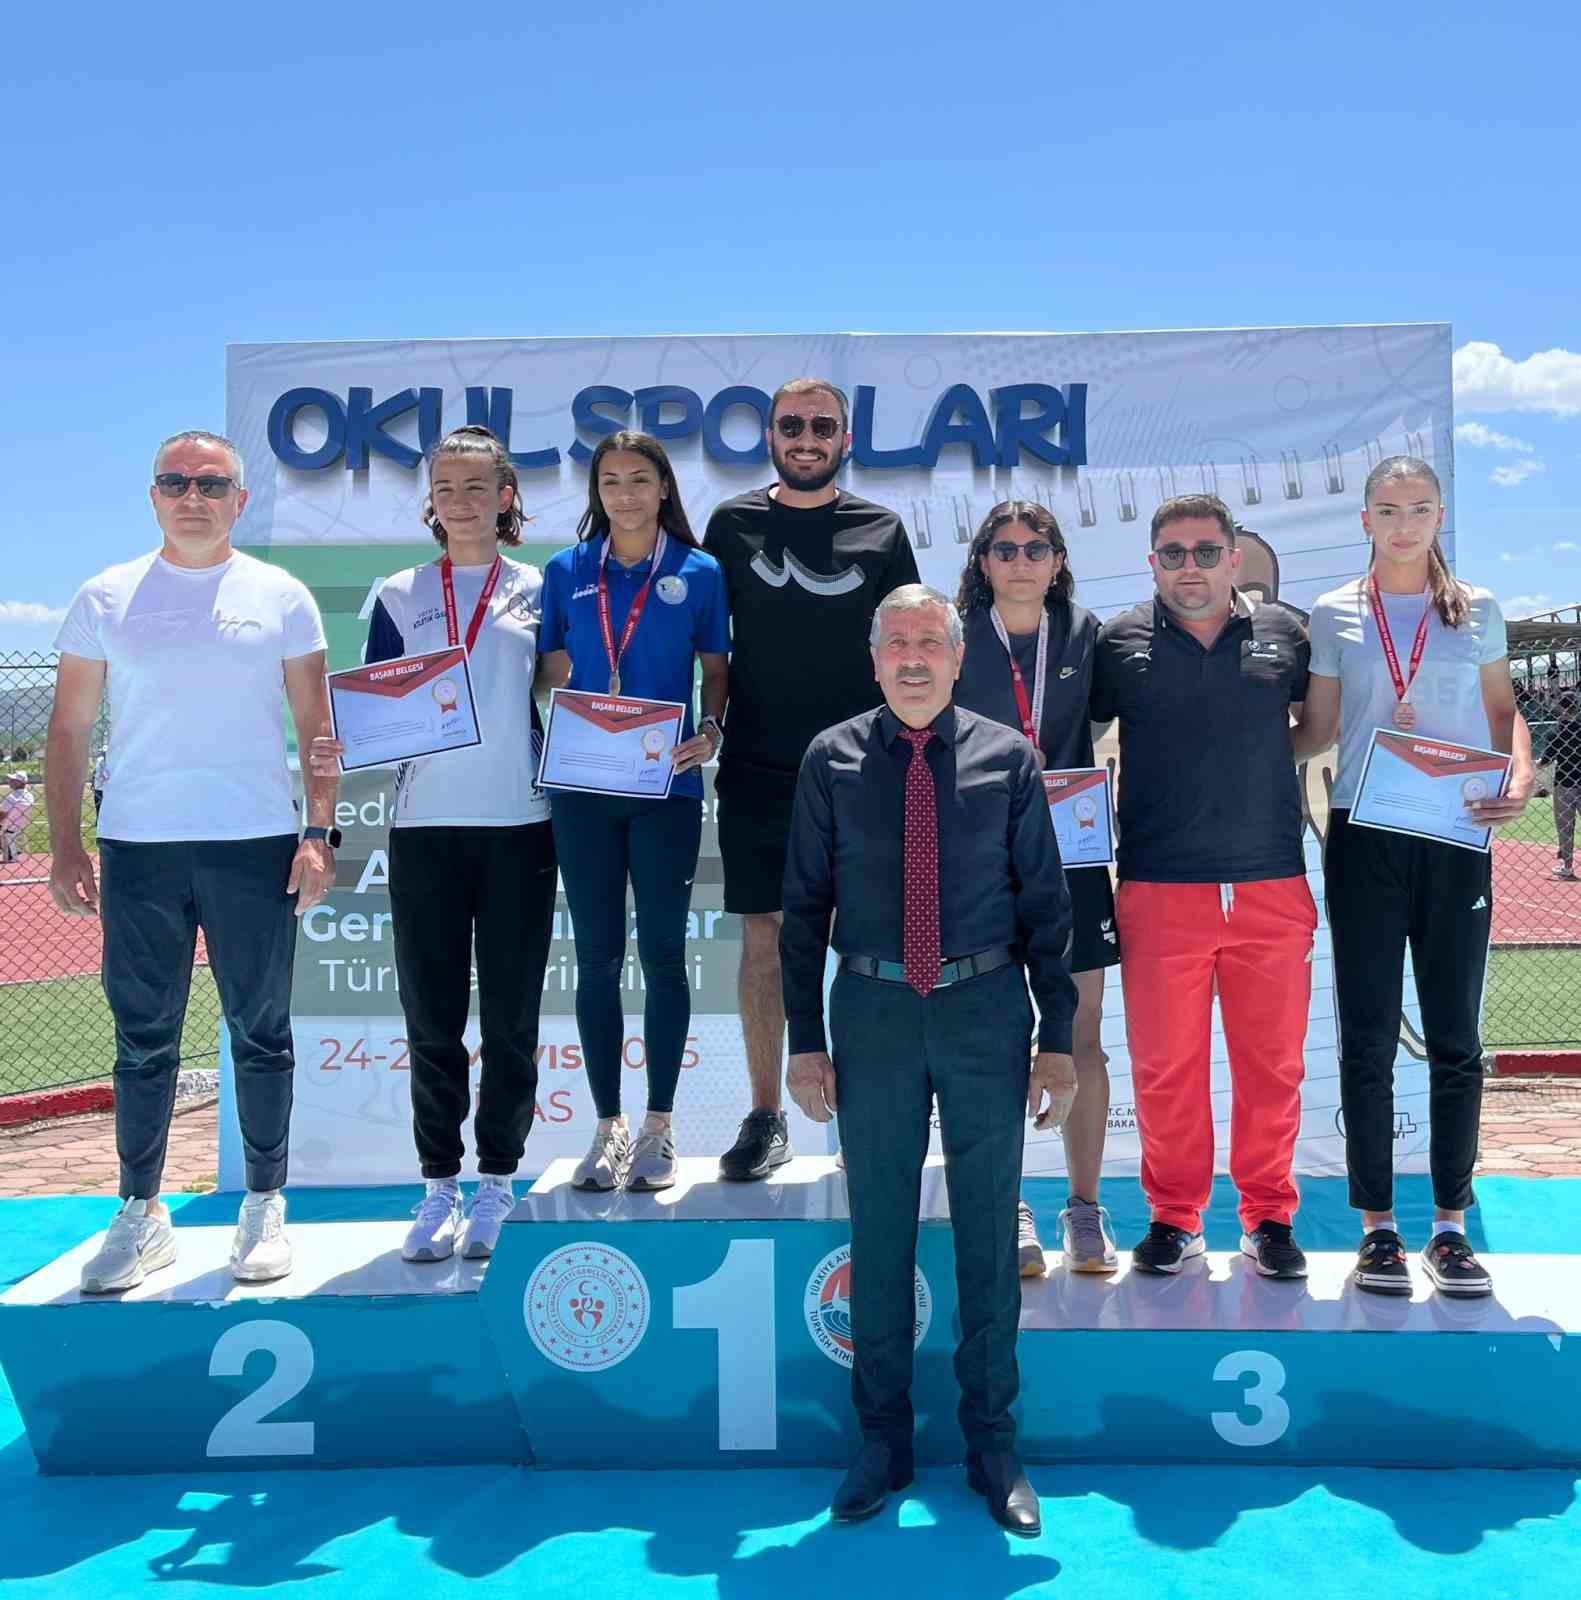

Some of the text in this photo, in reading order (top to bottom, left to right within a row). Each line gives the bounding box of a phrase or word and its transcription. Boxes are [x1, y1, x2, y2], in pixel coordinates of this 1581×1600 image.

[267, 384, 1088, 470] OKUL SPOLARI
[206, 1319, 315, 1456] 2
[673, 1239, 777, 1450] 1
[1210, 1350, 1290, 1446] 3
